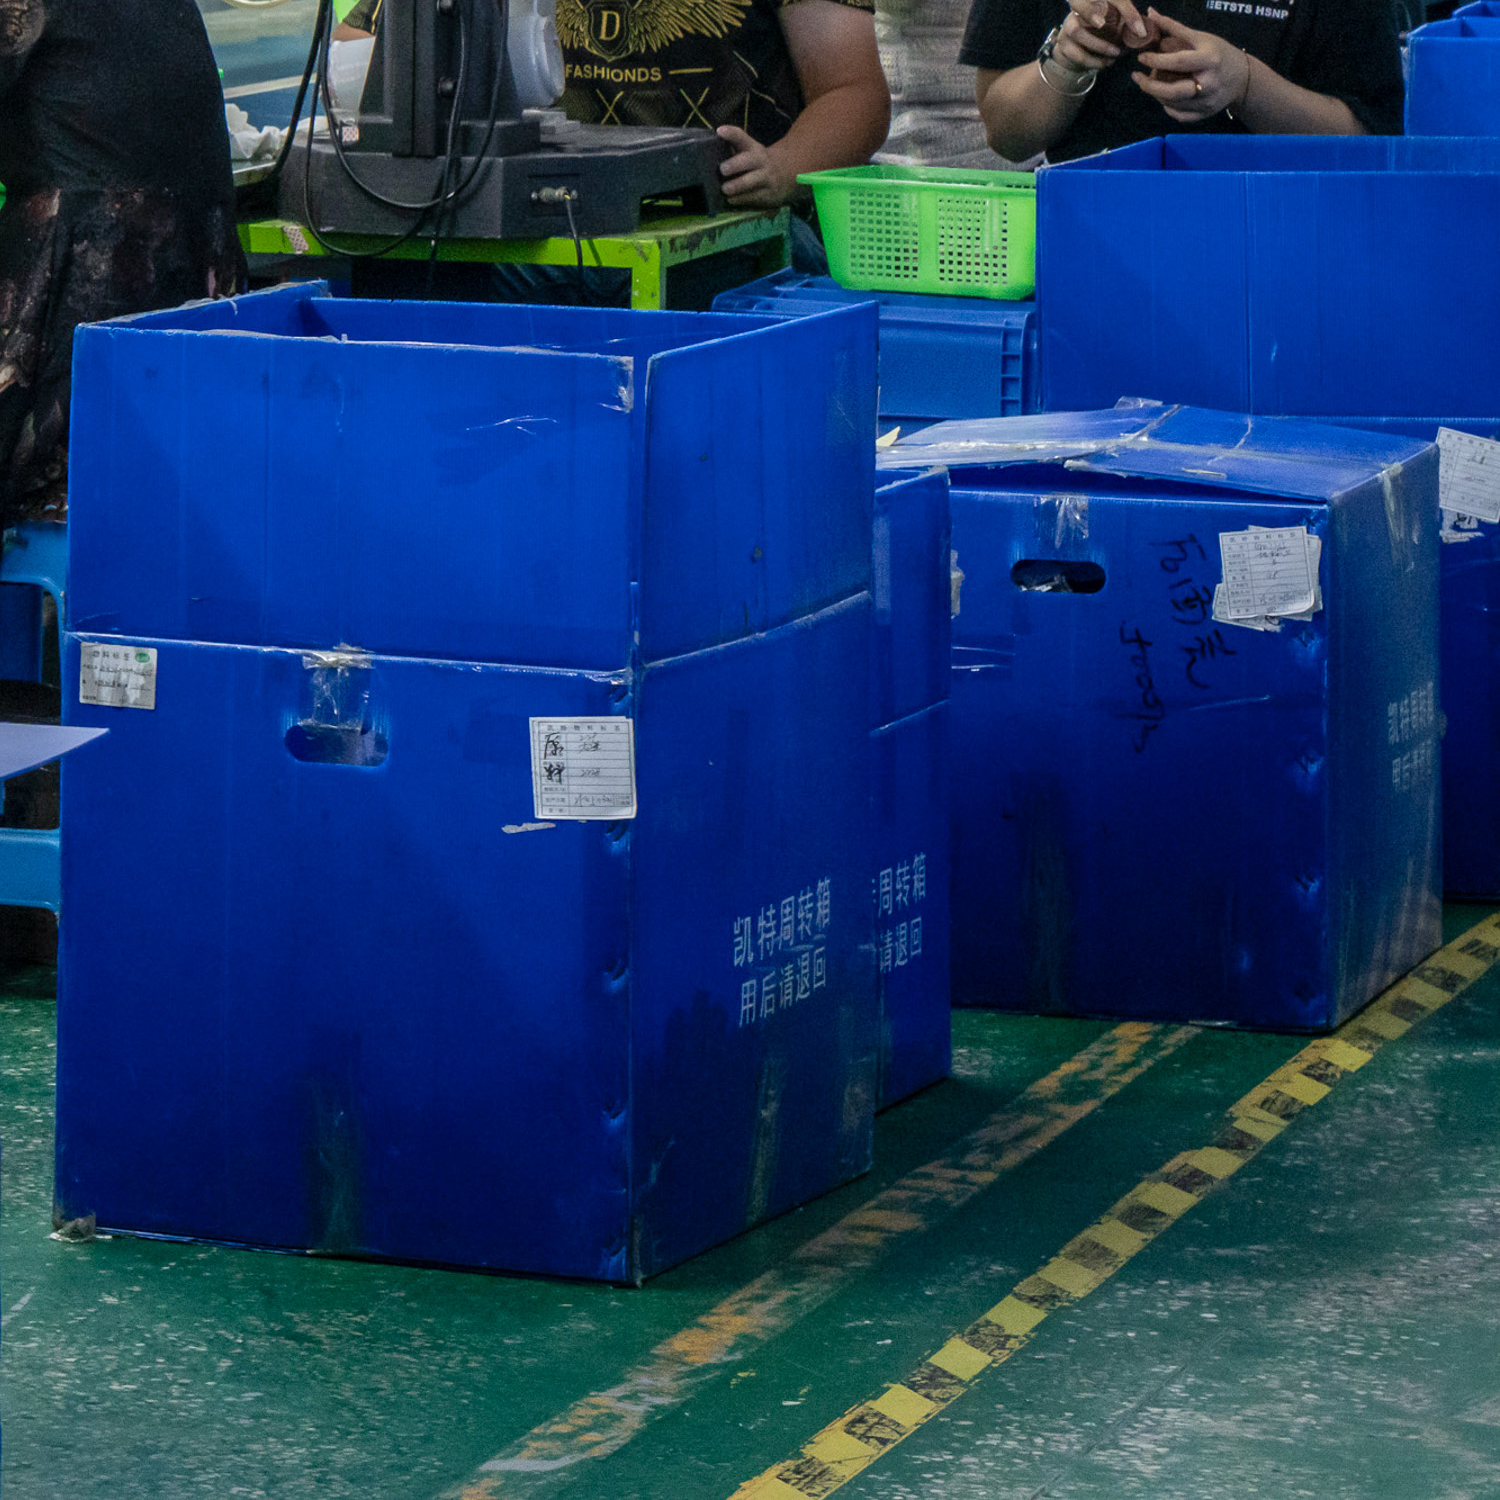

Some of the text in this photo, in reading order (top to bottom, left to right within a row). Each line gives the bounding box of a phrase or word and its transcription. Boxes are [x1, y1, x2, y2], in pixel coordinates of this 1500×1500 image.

[599, 10, 621, 41] D
[565, 63, 662, 83] FASHIONDS
[733, 875, 831, 968] 凯特周转箱
[739, 946, 827, 1029] 用后请退回
